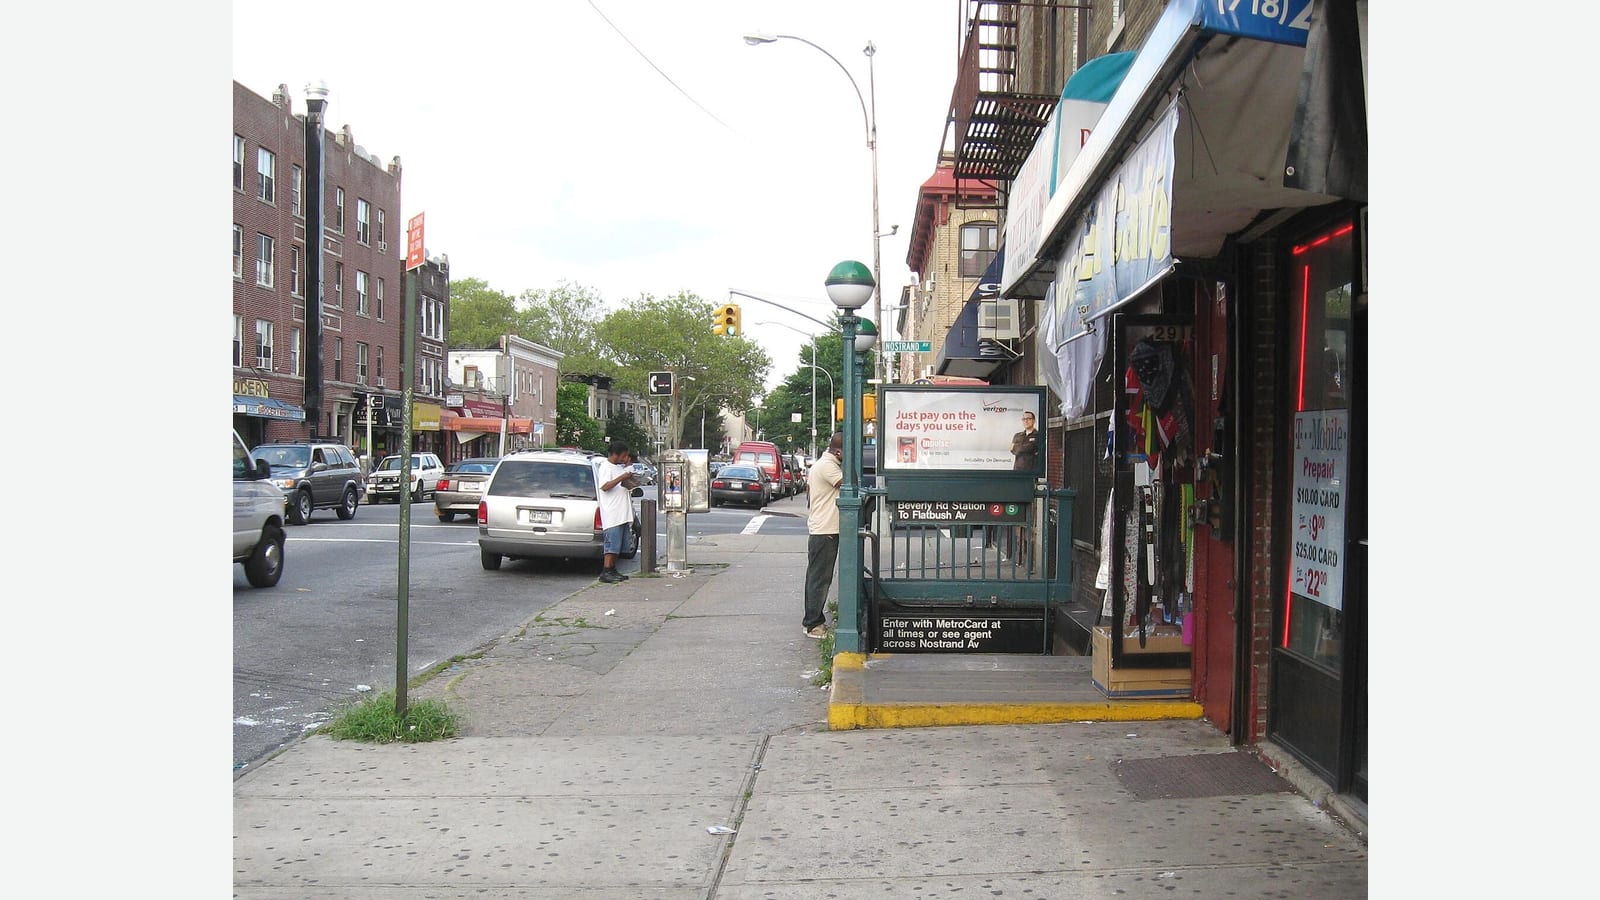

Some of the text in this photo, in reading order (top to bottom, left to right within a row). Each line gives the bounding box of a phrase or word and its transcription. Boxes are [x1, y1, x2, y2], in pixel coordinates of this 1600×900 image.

[885, 342, 920, 351] NOSTRAND
[896, 410, 976, 424] Just pay on the
[896, 421, 976, 432] days you use it.
[1304, 457, 1335, 482] Prepaid
[1297, 487, 1340, 509] $10.00 CARD
[898, 501, 985, 511] Beverly Rd Station
[898, 510, 967, 519] To Flatbush Av
[1296, 541, 1338, 567] $25.00 CARD
[883, 619, 1001, 629] Enter with MetroCard at
[883, 629, 992, 640] all times or see agent
[883, 639, 980, 649] across Nostrand Av
